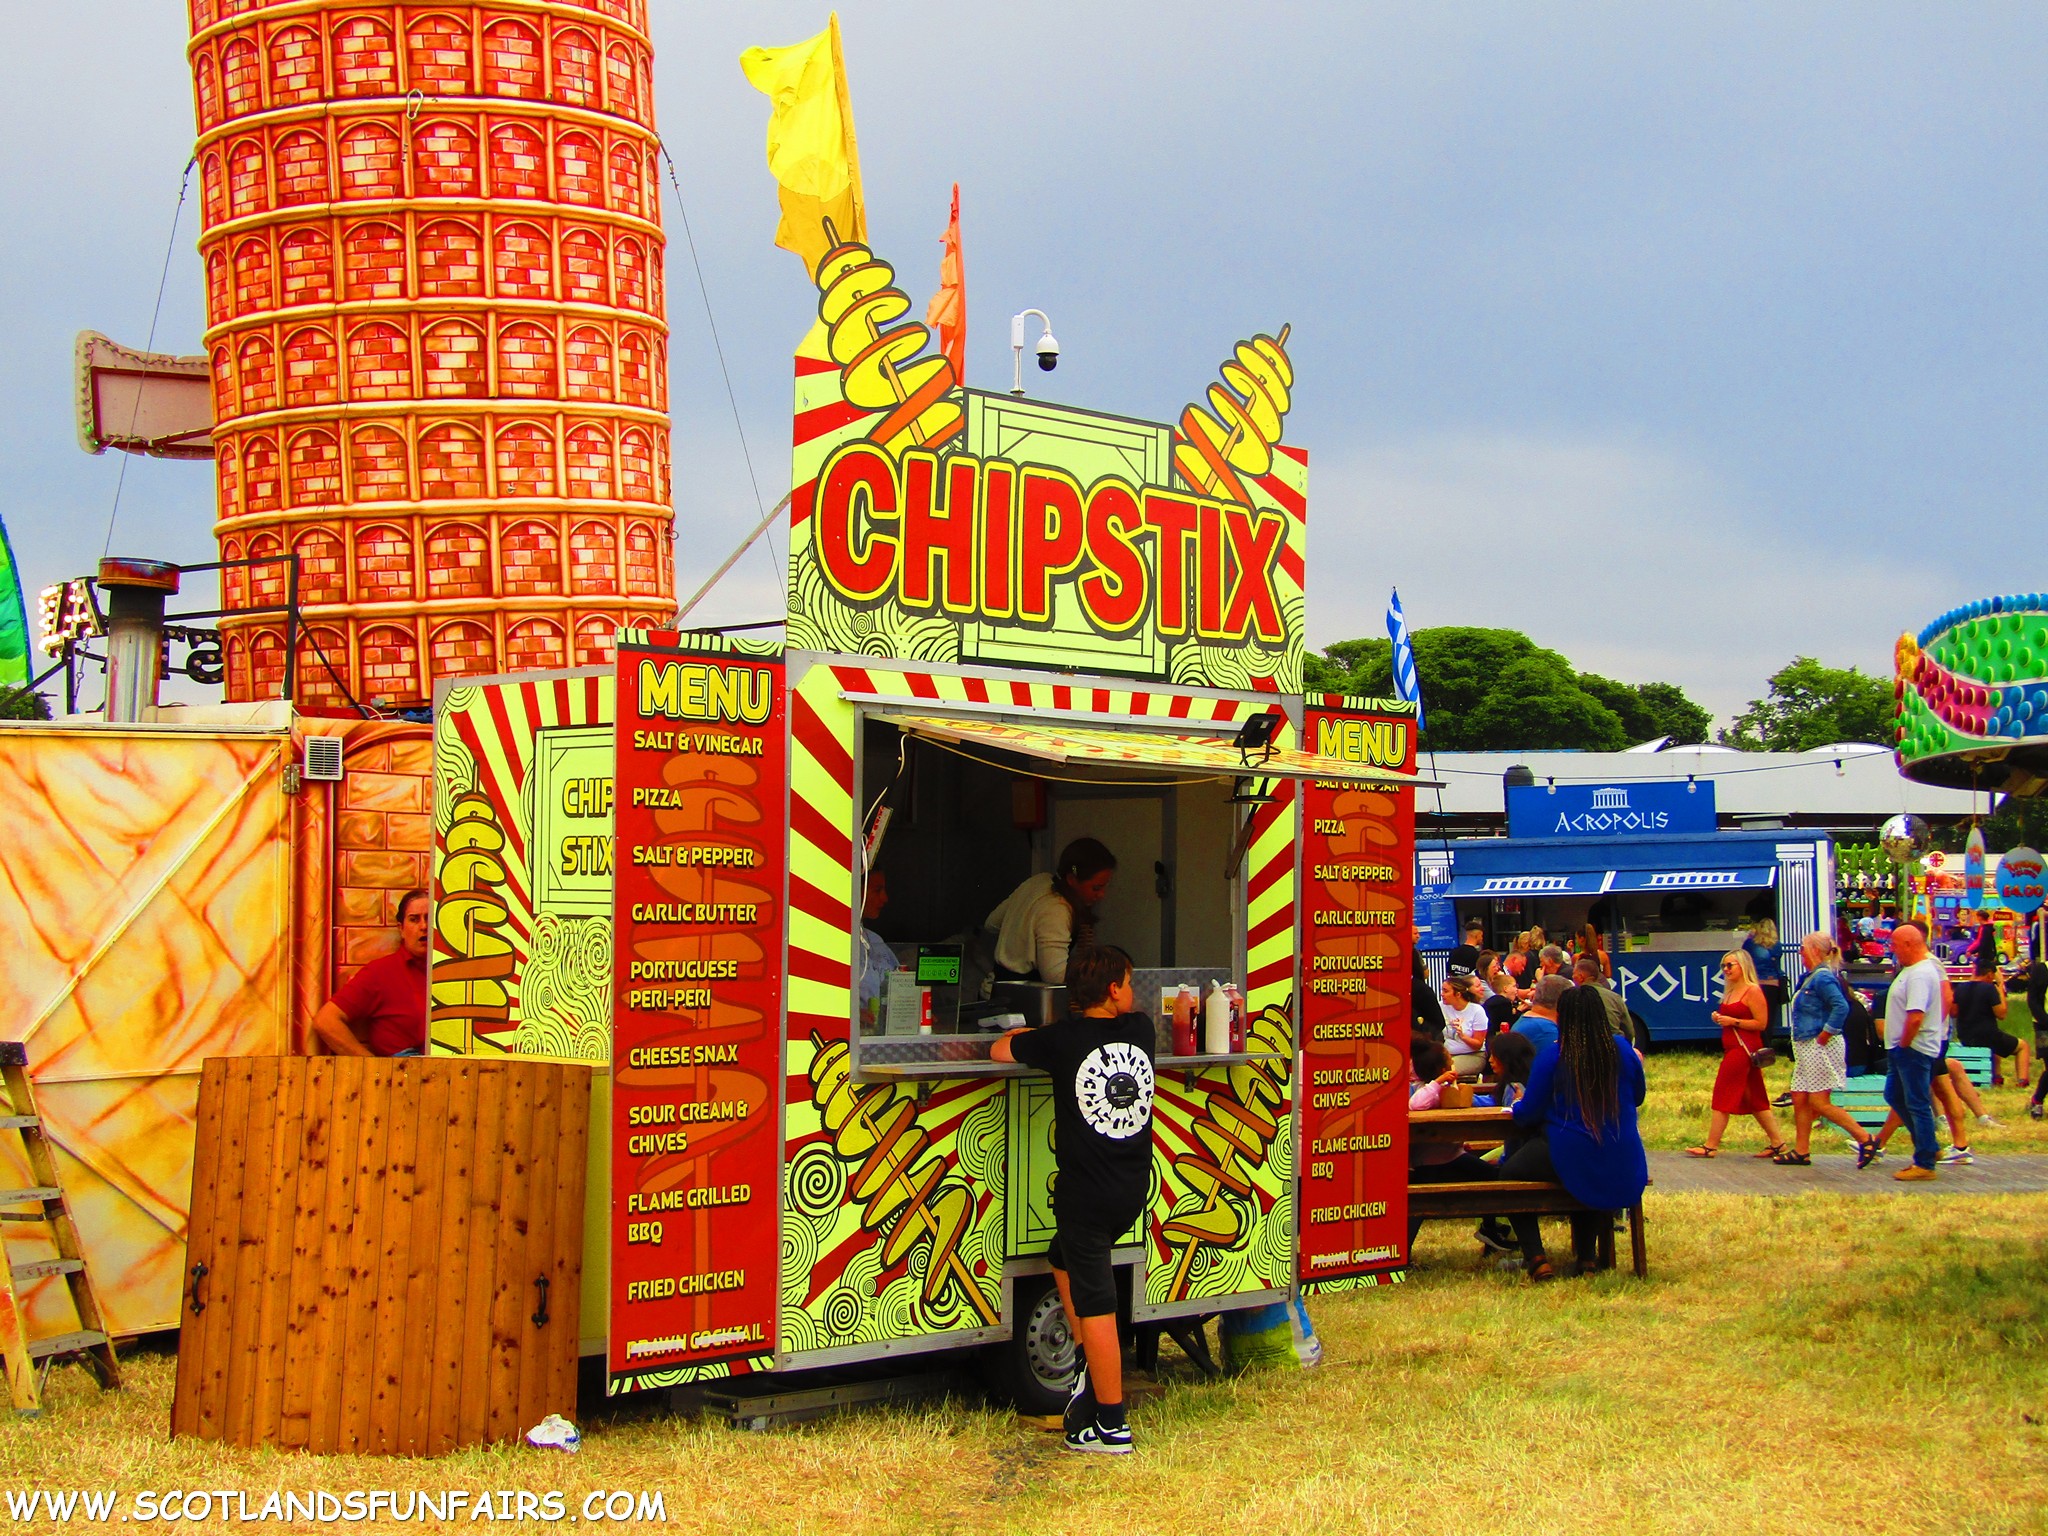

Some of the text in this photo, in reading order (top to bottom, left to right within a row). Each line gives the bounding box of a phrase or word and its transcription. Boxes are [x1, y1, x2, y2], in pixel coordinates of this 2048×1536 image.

[812, 441, 1287, 645] CHIPSTIX
[639, 660, 771, 723] MENU
[634, 731, 762, 754] SALT & VINEGAR
[1318, 717, 1406, 766] MENU
[563, 778, 613, 818] CHIP
[634, 788, 682, 806] PIZZA
[1315, 819, 1345, 833] PIZZA
[1554, 811, 1669, 832] ACROPOLIS
[633, 846, 753, 865] SALT & PEPPER
[1315, 865, 1392, 880] SALT & PEPPER
[632, 904, 756, 921] GARLIC BUTTER
[1314, 911, 1394, 924] GARLIC BUTTER
[631, 961, 737, 978] PORTUGUESE
[1314, 956, 1382, 970] PORTUGUESE
[1314, 979, 1365, 992] PERI-PERI
[631, 989, 710, 1008] PERI-PERI
[1314, 1023, 1383, 1038] CHEESE SNAX
[630, 1045, 737, 1066] CHEESE SNAX
[1314, 1067, 1389, 1084] SOUR CREAM &
[1313, 1092, 1350, 1107] CHIVES
[630, 1100, 747, 1124] SOUR CREAM &
[629, 1133, 687, 1153] CHIVES
[1313, 1134, 1390, 1153] FLAME GRILLED
[1312, 1162, 1333, 1178] BBQ
[629, 1185, 750, 1212] FLAME GRILLED
[1311, 1202, 1385, 1222] FRIED CHICKEN
[629, 1222, 662, 1243] BBQ
[629, 1270, 744, 1300] FRIED CHICKEN
